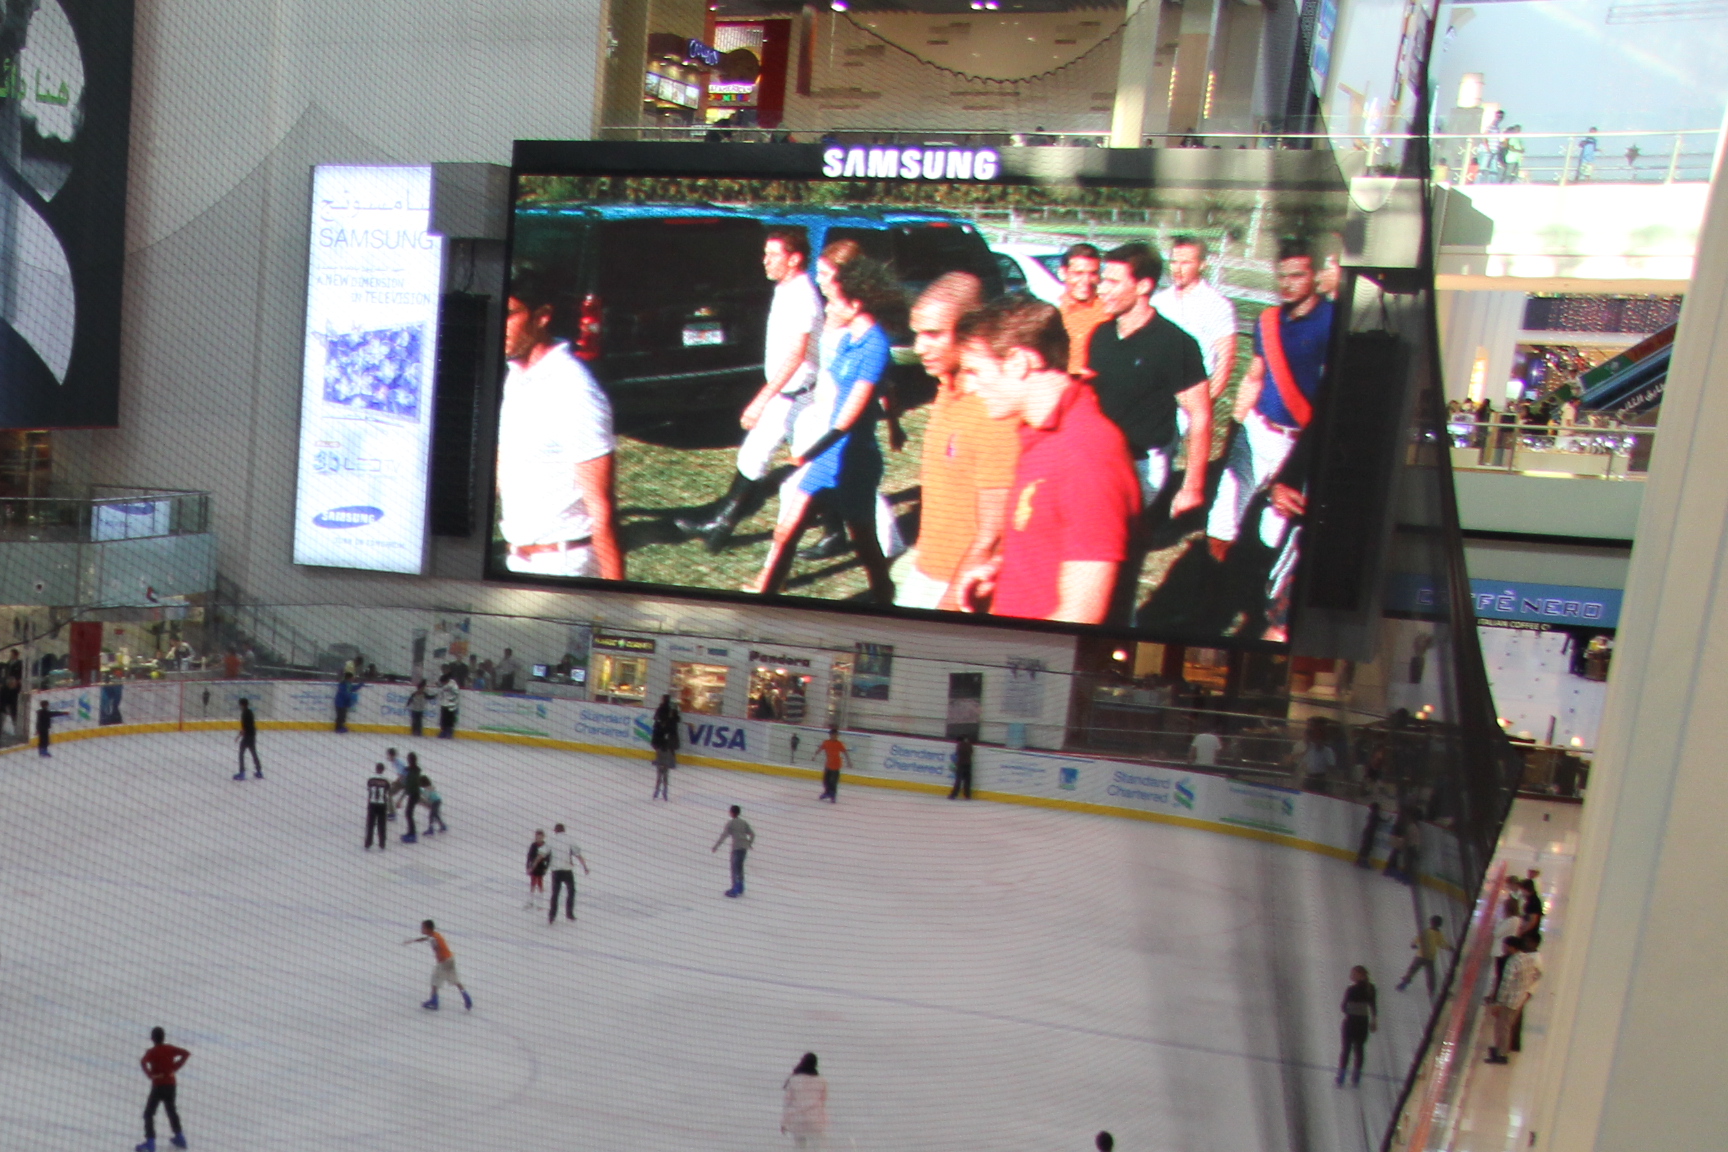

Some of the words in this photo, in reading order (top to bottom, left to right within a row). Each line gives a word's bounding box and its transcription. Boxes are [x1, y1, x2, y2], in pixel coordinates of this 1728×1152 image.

[35, 68, 70, 107] هنا
[822, 148, 998, 181] SAMSUNG
[319, 228, 434, 250] SAMSUNG
[321, 511, 376, 525] SAMSUNG
[1522, 598, 1603, 619] NERO
[1510, 621, 1540, 631] COFFEE
[749, 650, 811, 668] Pandora
[683, 722, 747, 751] VISA
